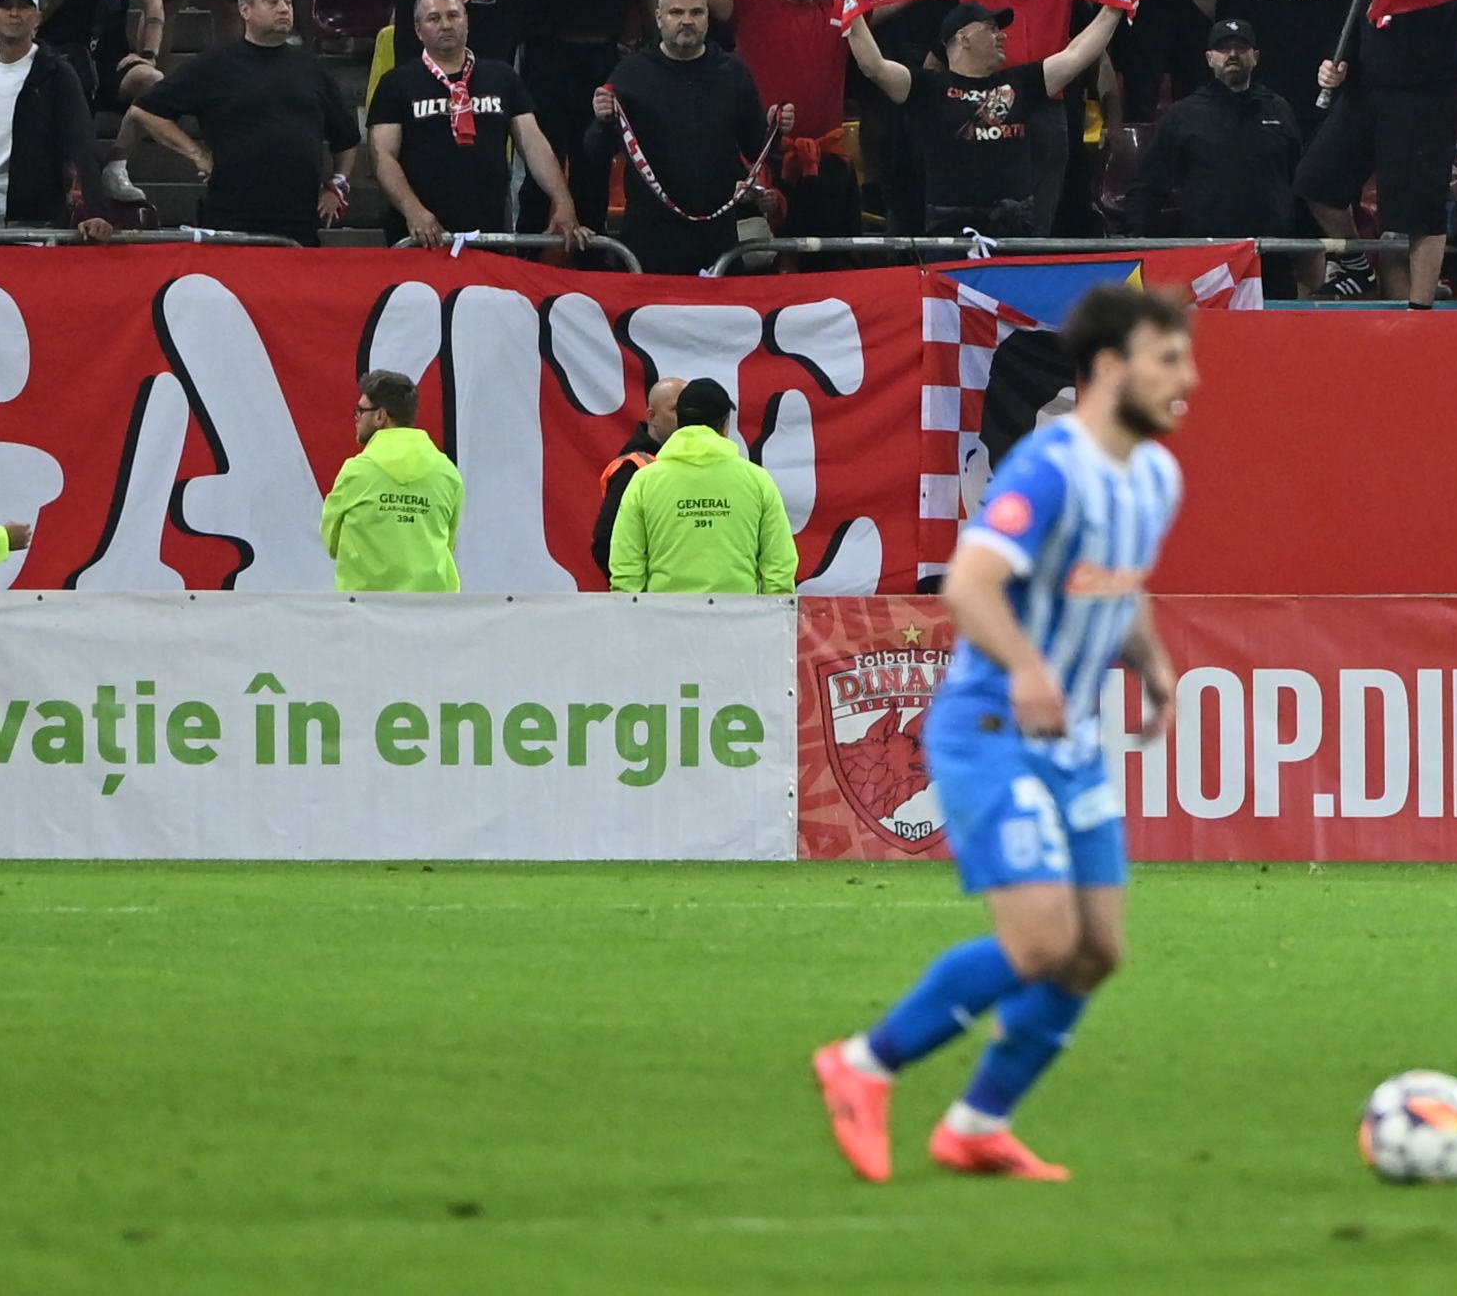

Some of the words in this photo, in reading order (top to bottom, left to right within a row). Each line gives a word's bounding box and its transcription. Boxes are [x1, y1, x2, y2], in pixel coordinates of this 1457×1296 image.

[378, 493, 430, 508] GENERAL
[676, 498, 732, 511] GENERAL
[693, 519, 714, 529] 391
[261, 661, 344, 765] în
[376, 678, 765, 785] energie
